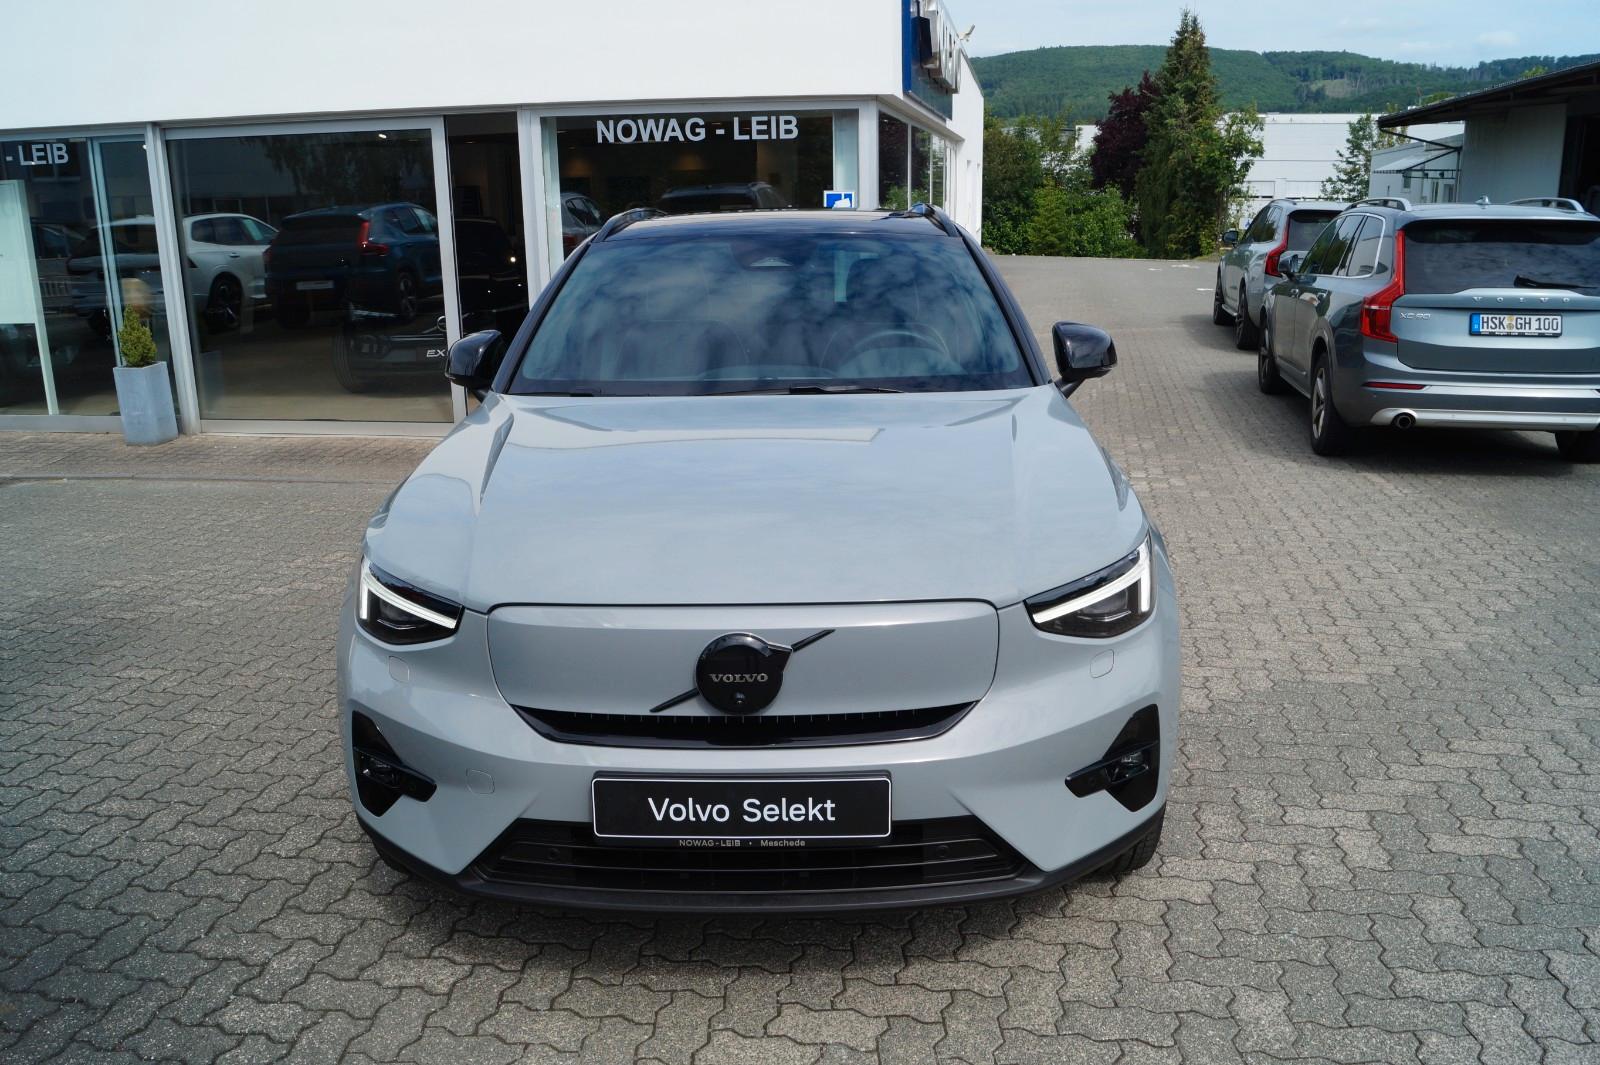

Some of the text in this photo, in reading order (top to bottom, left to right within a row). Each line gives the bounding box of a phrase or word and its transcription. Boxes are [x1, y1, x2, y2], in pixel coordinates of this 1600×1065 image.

[596, 117, 706, 144] NOWAG
[733, 115, 799, 140] LEIB
[18, 143, 69, 166] LEIB
[1472, 296, 1570, 304] VOLVO
[1481, 316, 1559, 331] HSK GH 100
[709, 673, 769, 684] VOLVO
[648, 797, 836, 822] Volvo Selekt
[760, 839, 806, 847] Meschede
